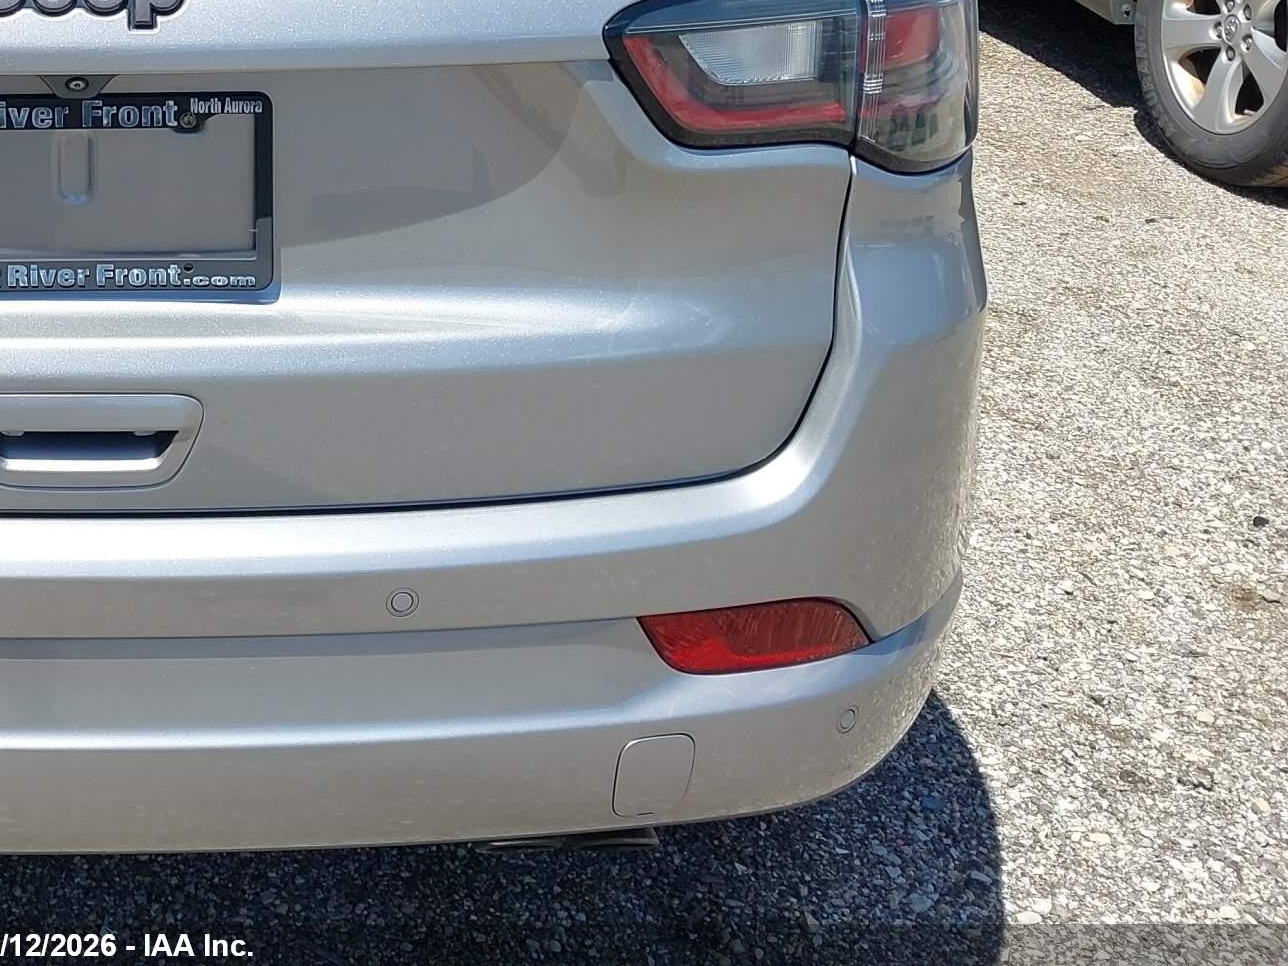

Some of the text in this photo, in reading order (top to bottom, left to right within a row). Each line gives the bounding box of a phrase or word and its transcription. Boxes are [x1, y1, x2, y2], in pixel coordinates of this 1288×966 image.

[81, 99, 178, 128] Front
[190, 98, 263, 114] North Aurora
[7, 265, 90, 288] River
[95, 264, 256, 287] Front.com
